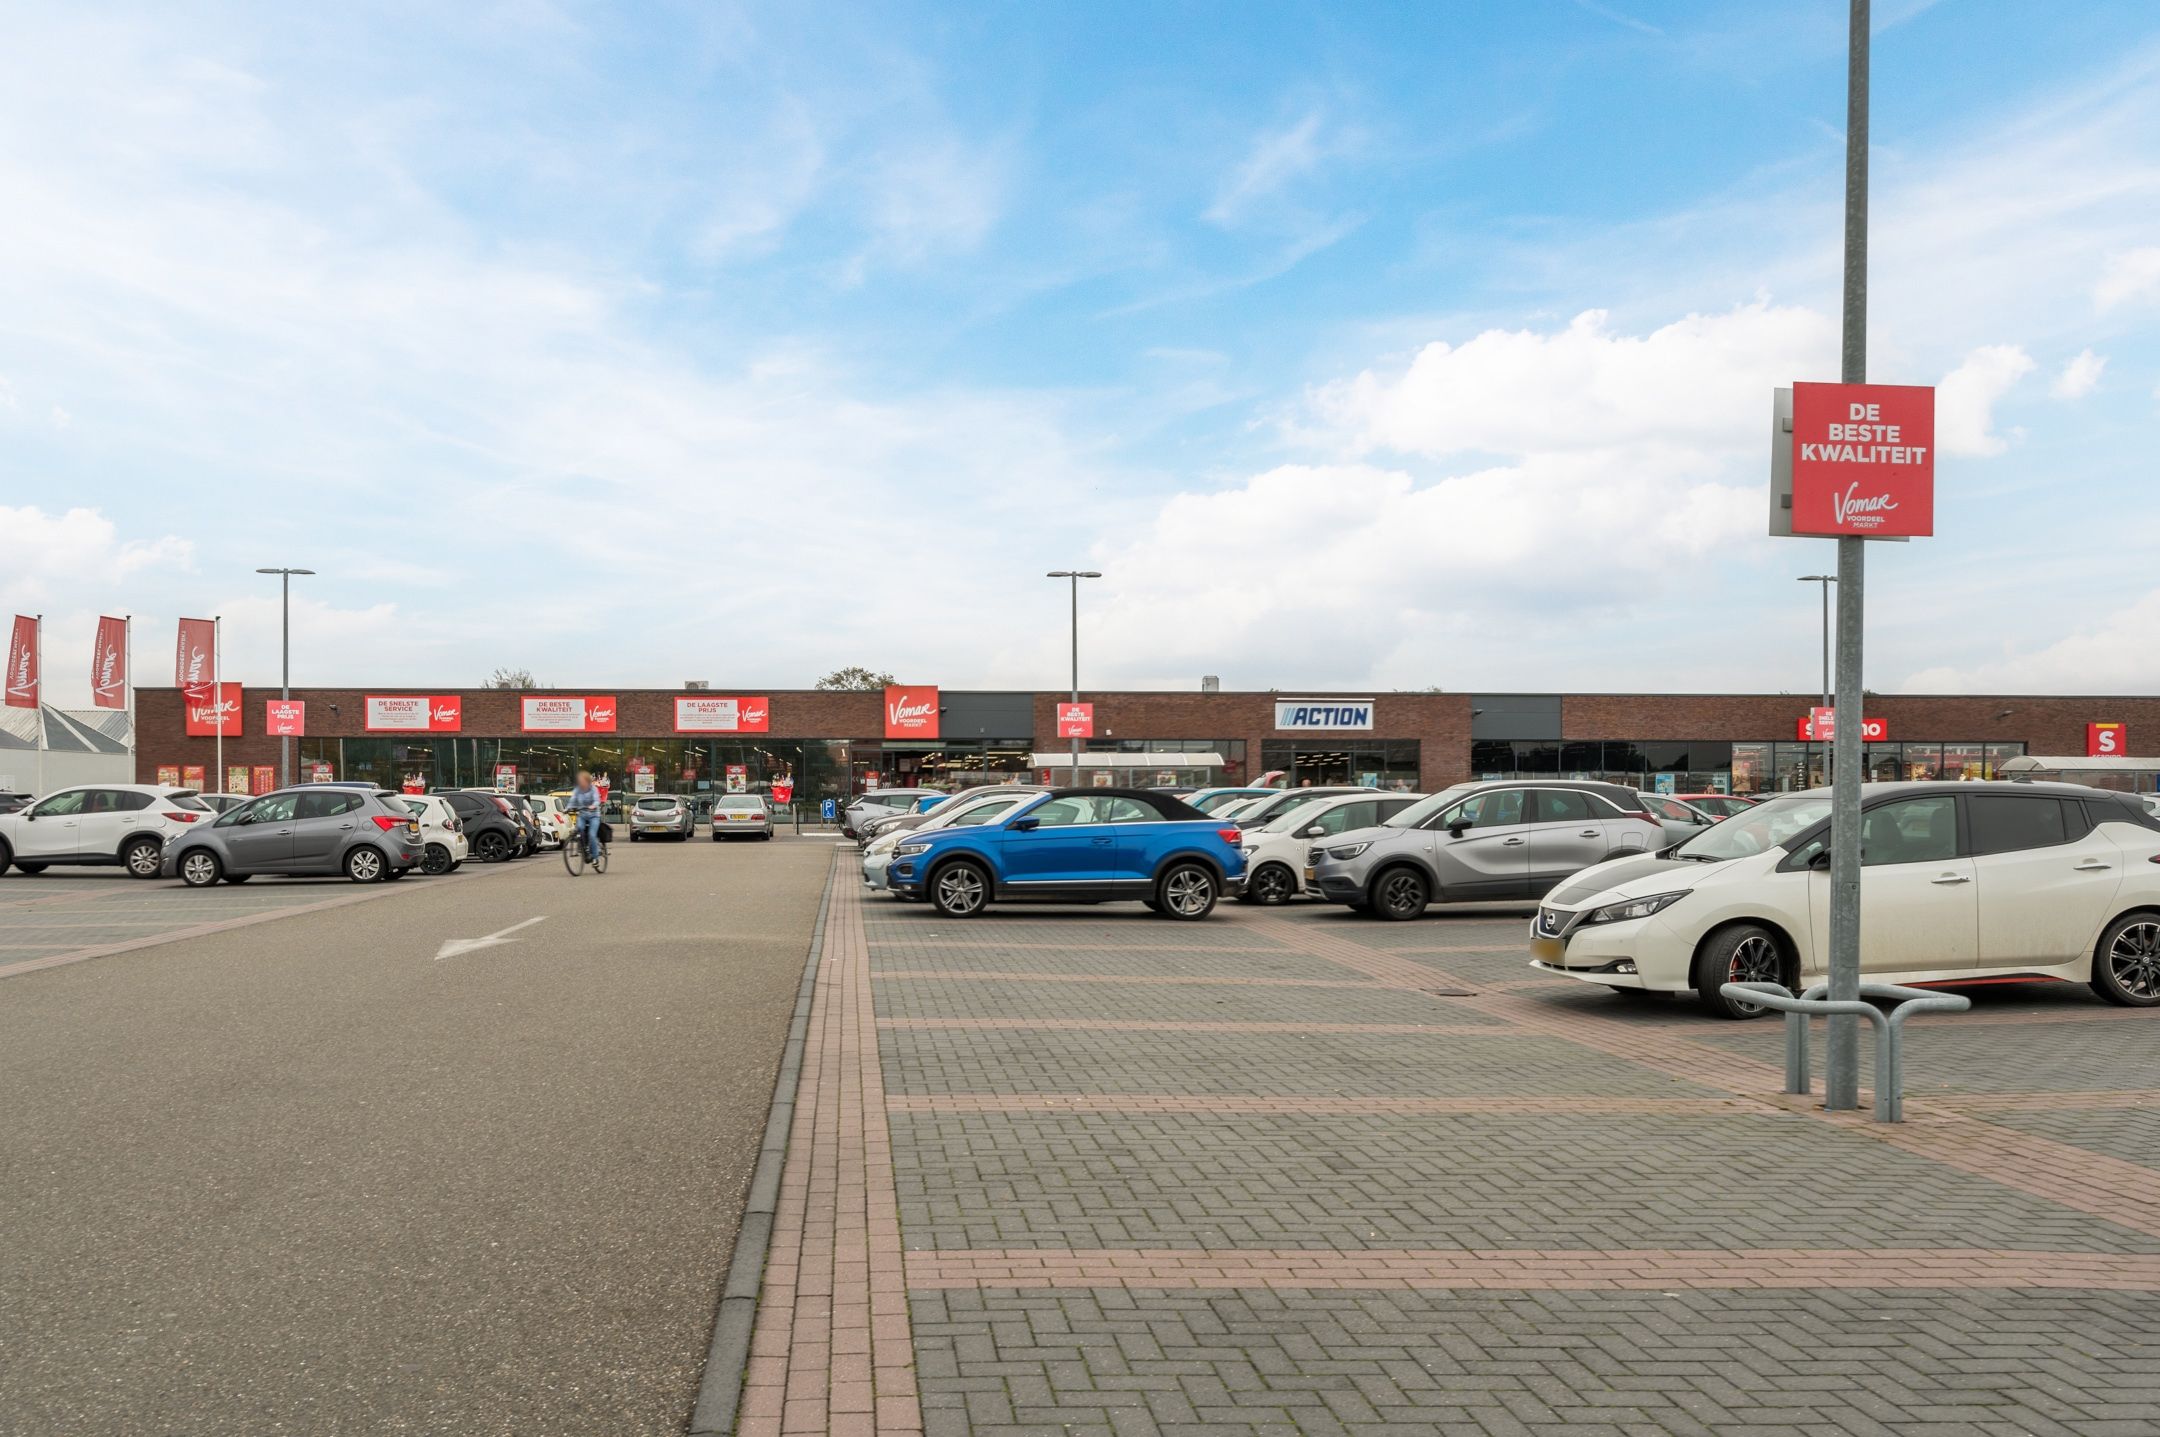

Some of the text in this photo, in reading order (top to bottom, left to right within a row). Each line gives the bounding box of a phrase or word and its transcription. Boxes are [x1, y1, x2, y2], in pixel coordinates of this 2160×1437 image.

[1850, 403, 1880, 421] DE
[1829, 423, 1900, 443] BESTE
[1801, 443, 1926, 464] KWALITEIT
[1834, 481, 1899, 524] Vomar
[1847, 515, 1885, 523] VOORDEEL
[890, 695, 936, 725] Vomar
[1292, 707, 1368, 726] ACTION
[2099, 731, 2115, 752] S
[825, 802, 832, 810] P
